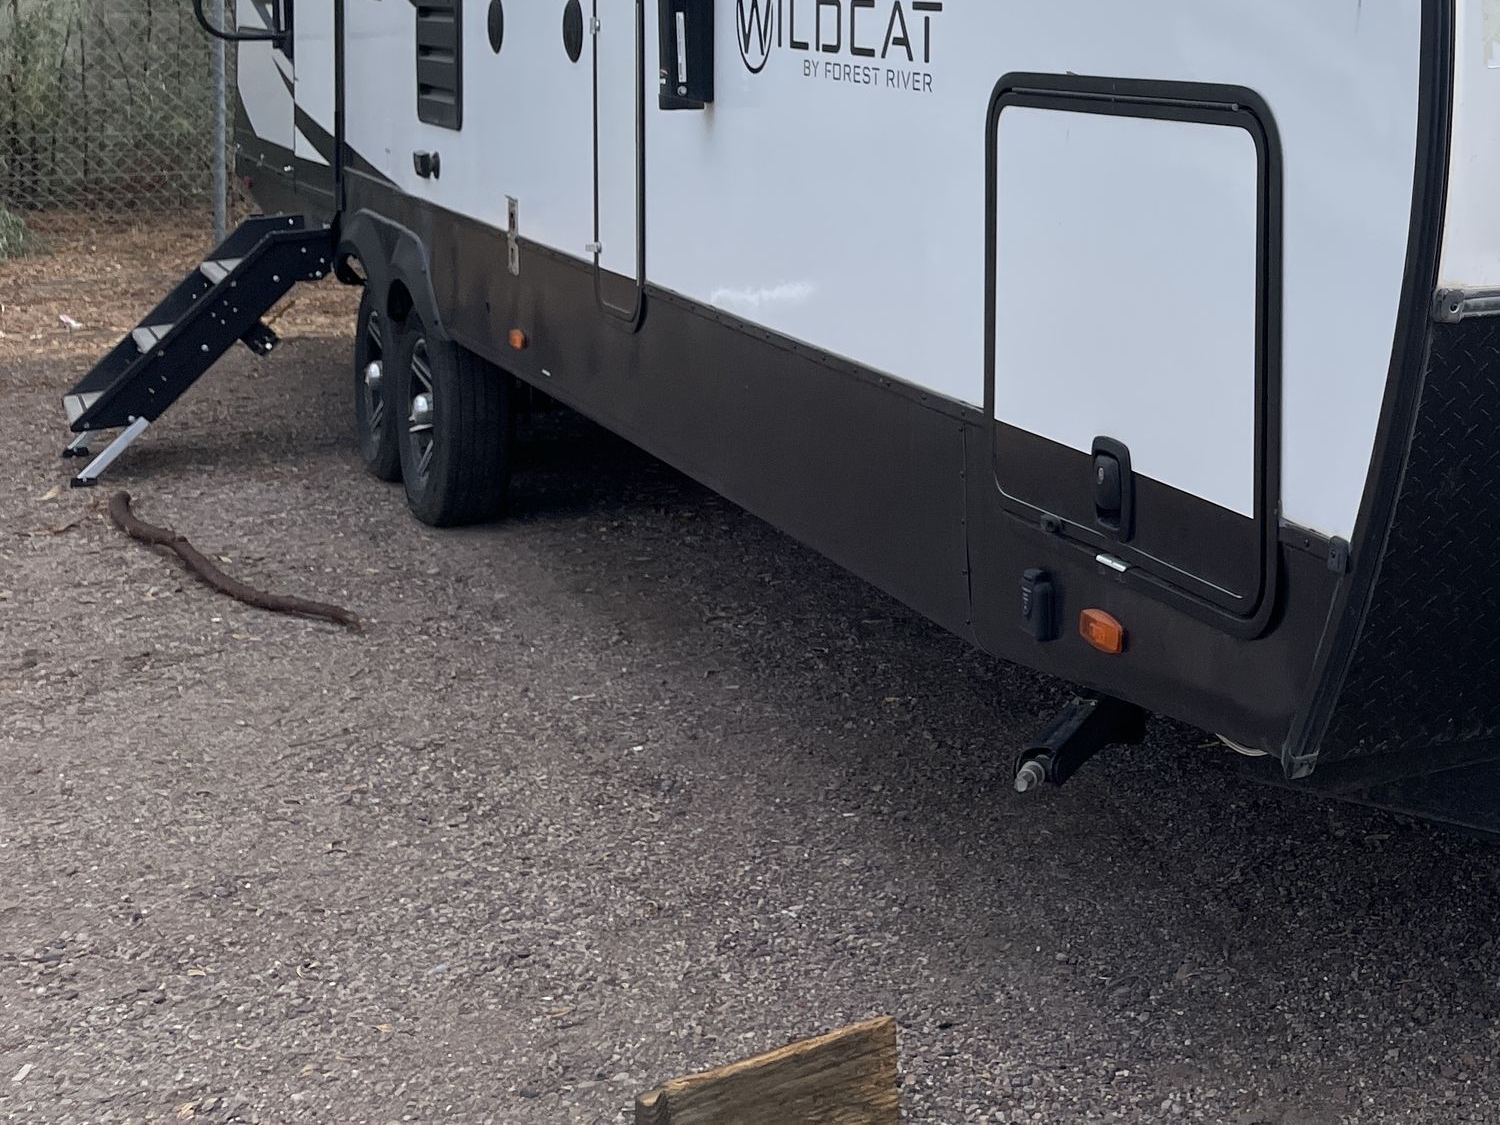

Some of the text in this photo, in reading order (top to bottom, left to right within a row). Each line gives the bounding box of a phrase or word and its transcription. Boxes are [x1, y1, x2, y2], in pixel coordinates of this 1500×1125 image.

[803, 59, 933, 93] BY FOREST RIVER
